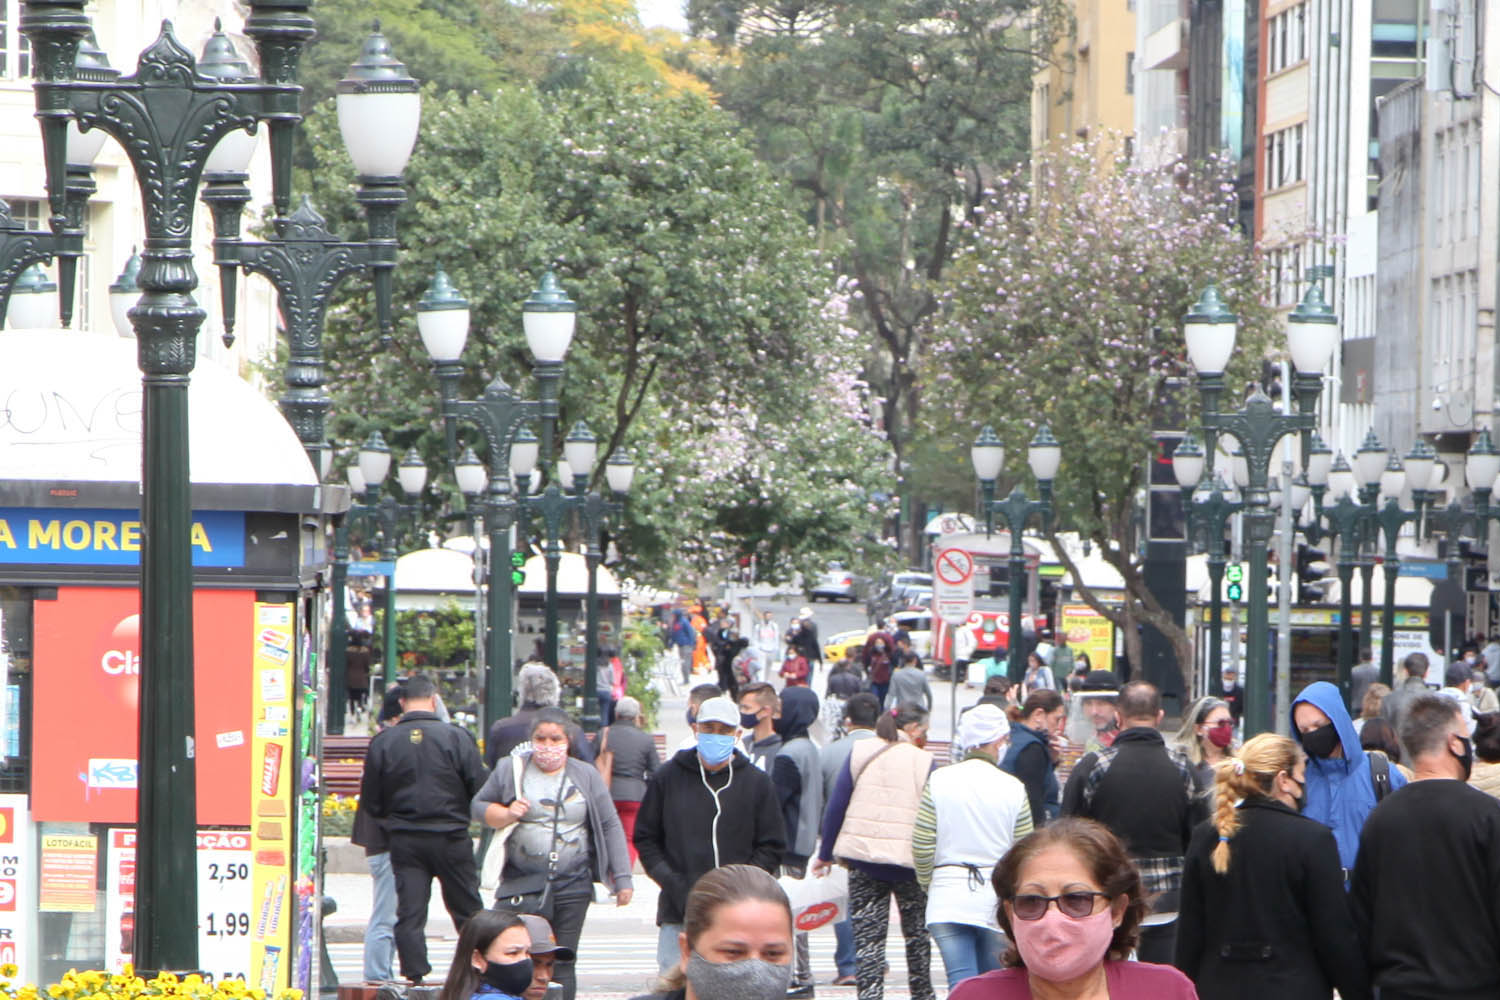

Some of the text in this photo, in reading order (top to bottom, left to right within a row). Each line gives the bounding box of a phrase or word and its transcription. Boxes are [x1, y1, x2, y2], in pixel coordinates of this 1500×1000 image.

[28, 519, 213, 552] MOREA
[208, 863, 248, 884] 2,50
[206, 912, 249, 938] 1,99
